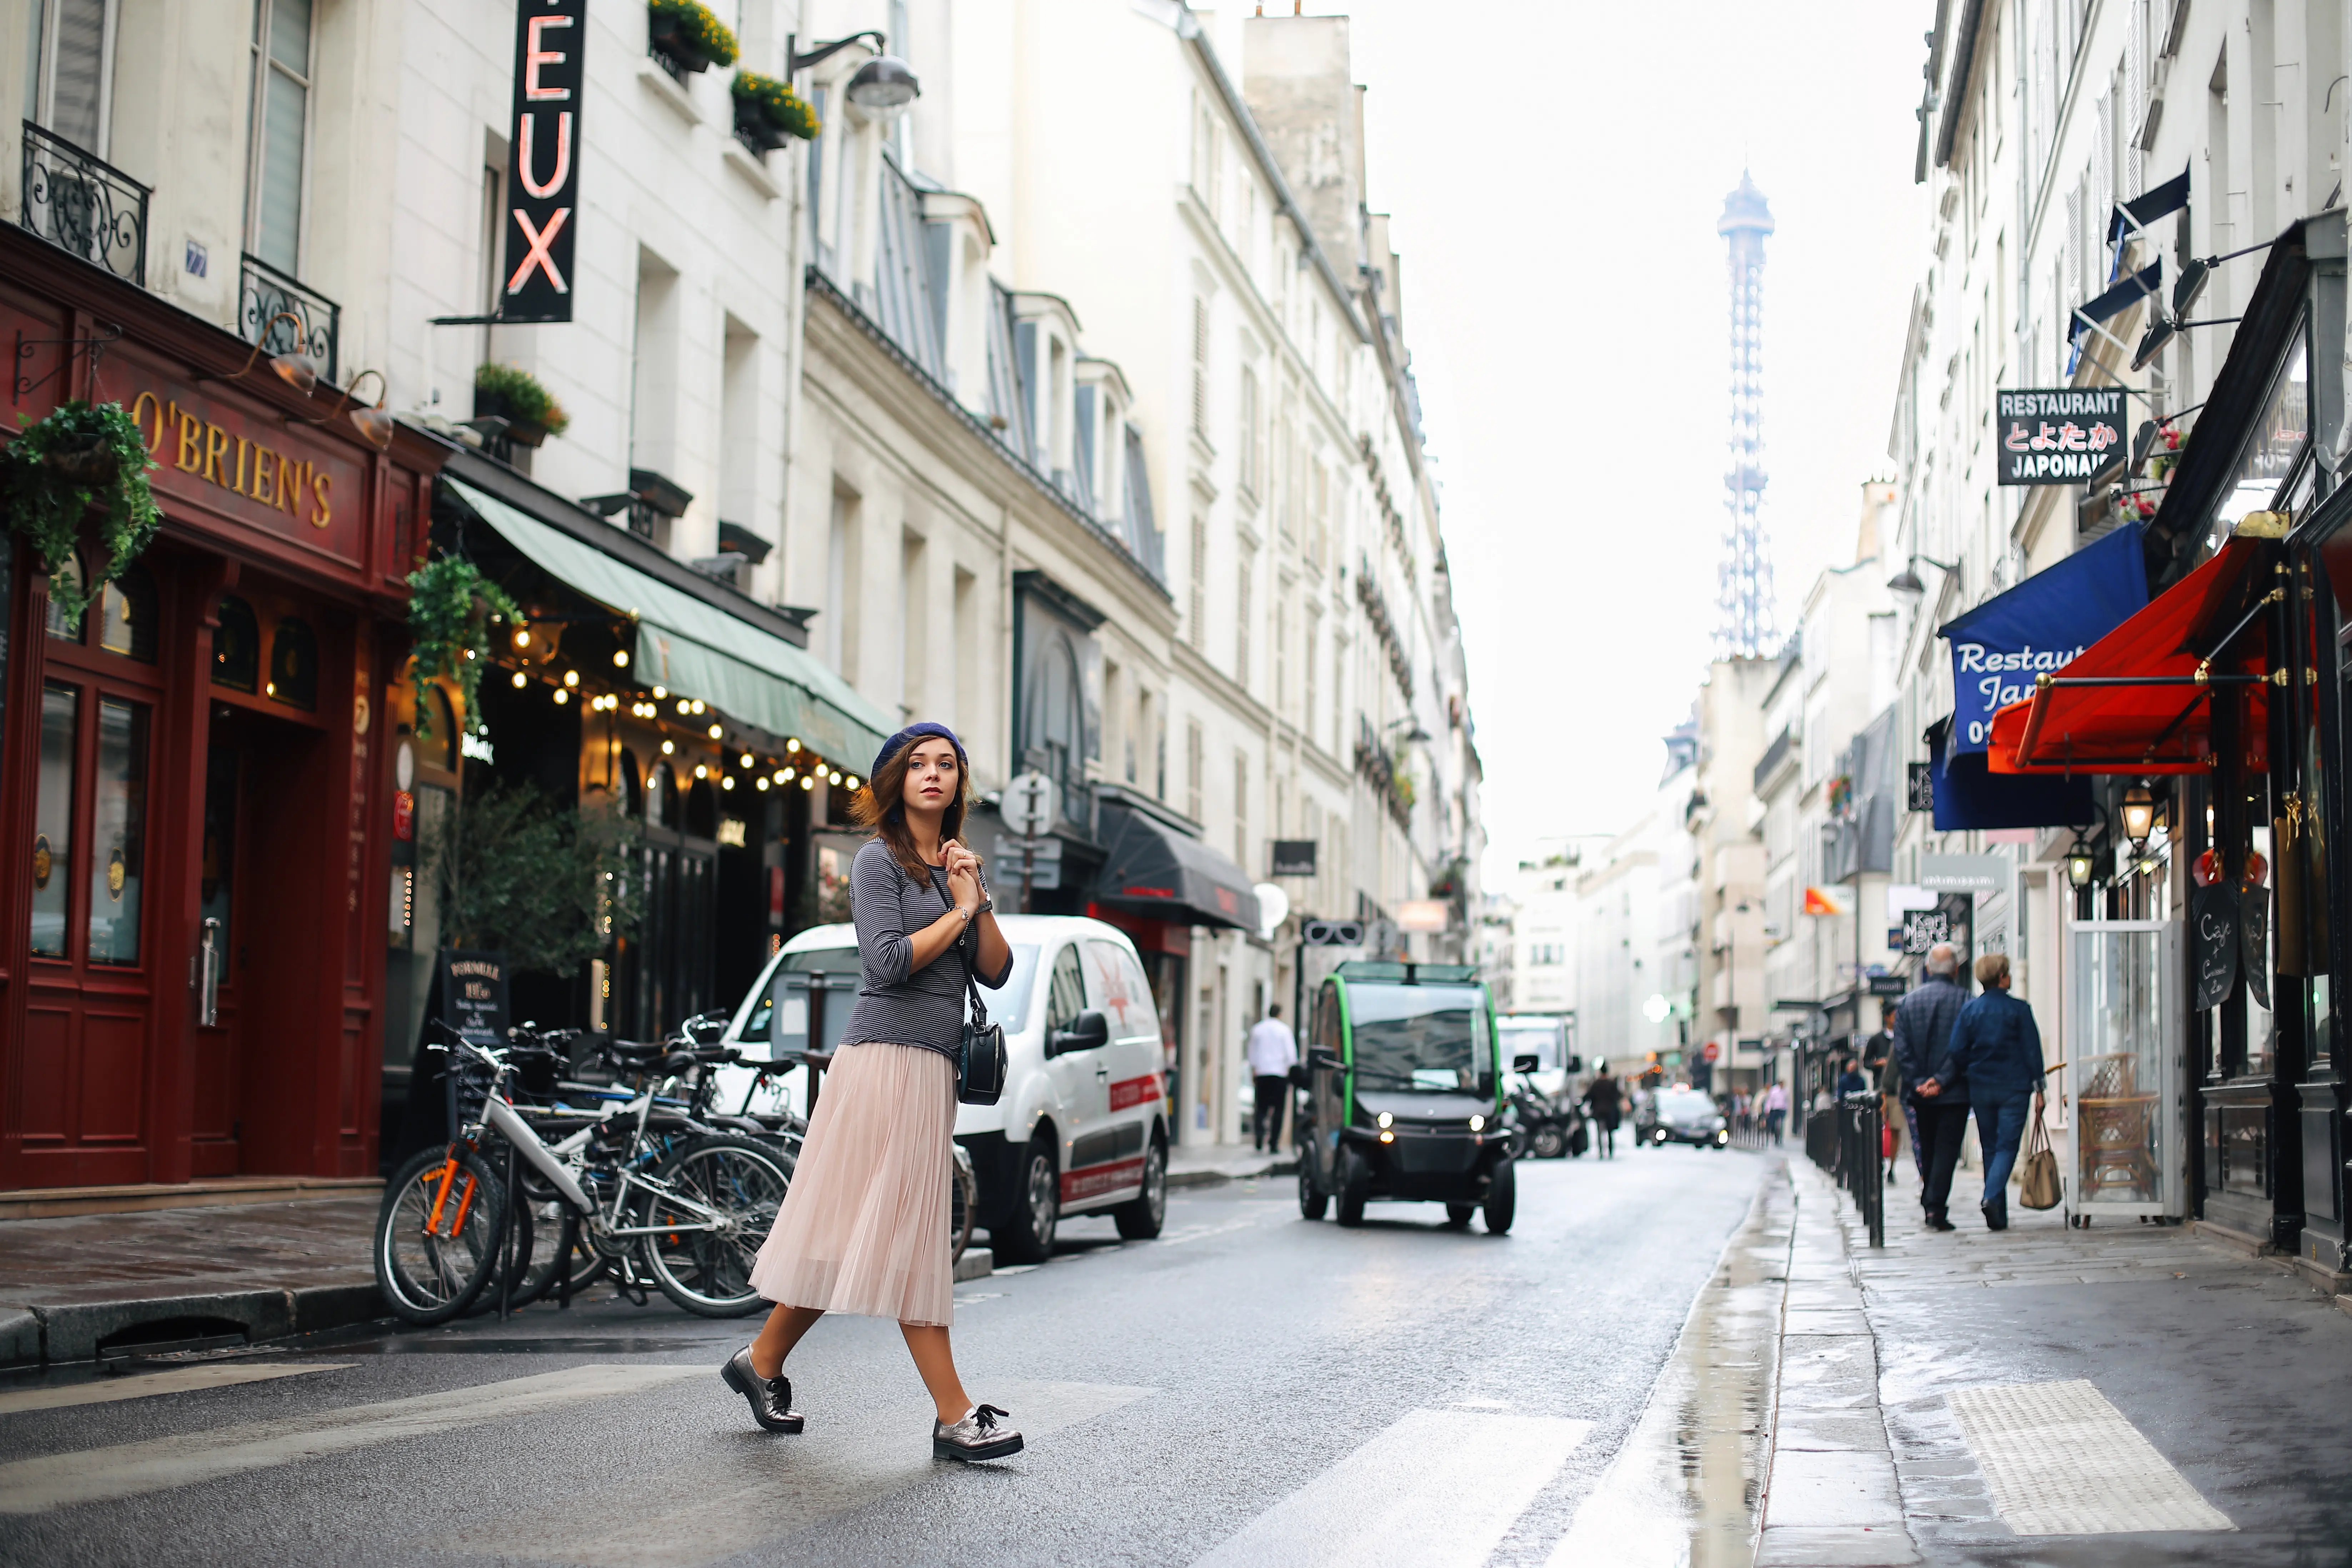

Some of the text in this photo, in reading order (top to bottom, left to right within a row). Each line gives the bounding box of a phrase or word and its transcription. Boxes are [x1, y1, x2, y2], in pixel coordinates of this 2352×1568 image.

[507, 0, 574, 295] EUX
[188, 243, 206, 276] 77
[2000, 392, 2121, 417] RESTAURANT
[2004, 420, 2118, 452] とよたか
[132, 391, 332, 529] O'BRIEN'S
[1904, 923, 1948, 941] Marc
[1911, 911, 1947, 929] Karl
